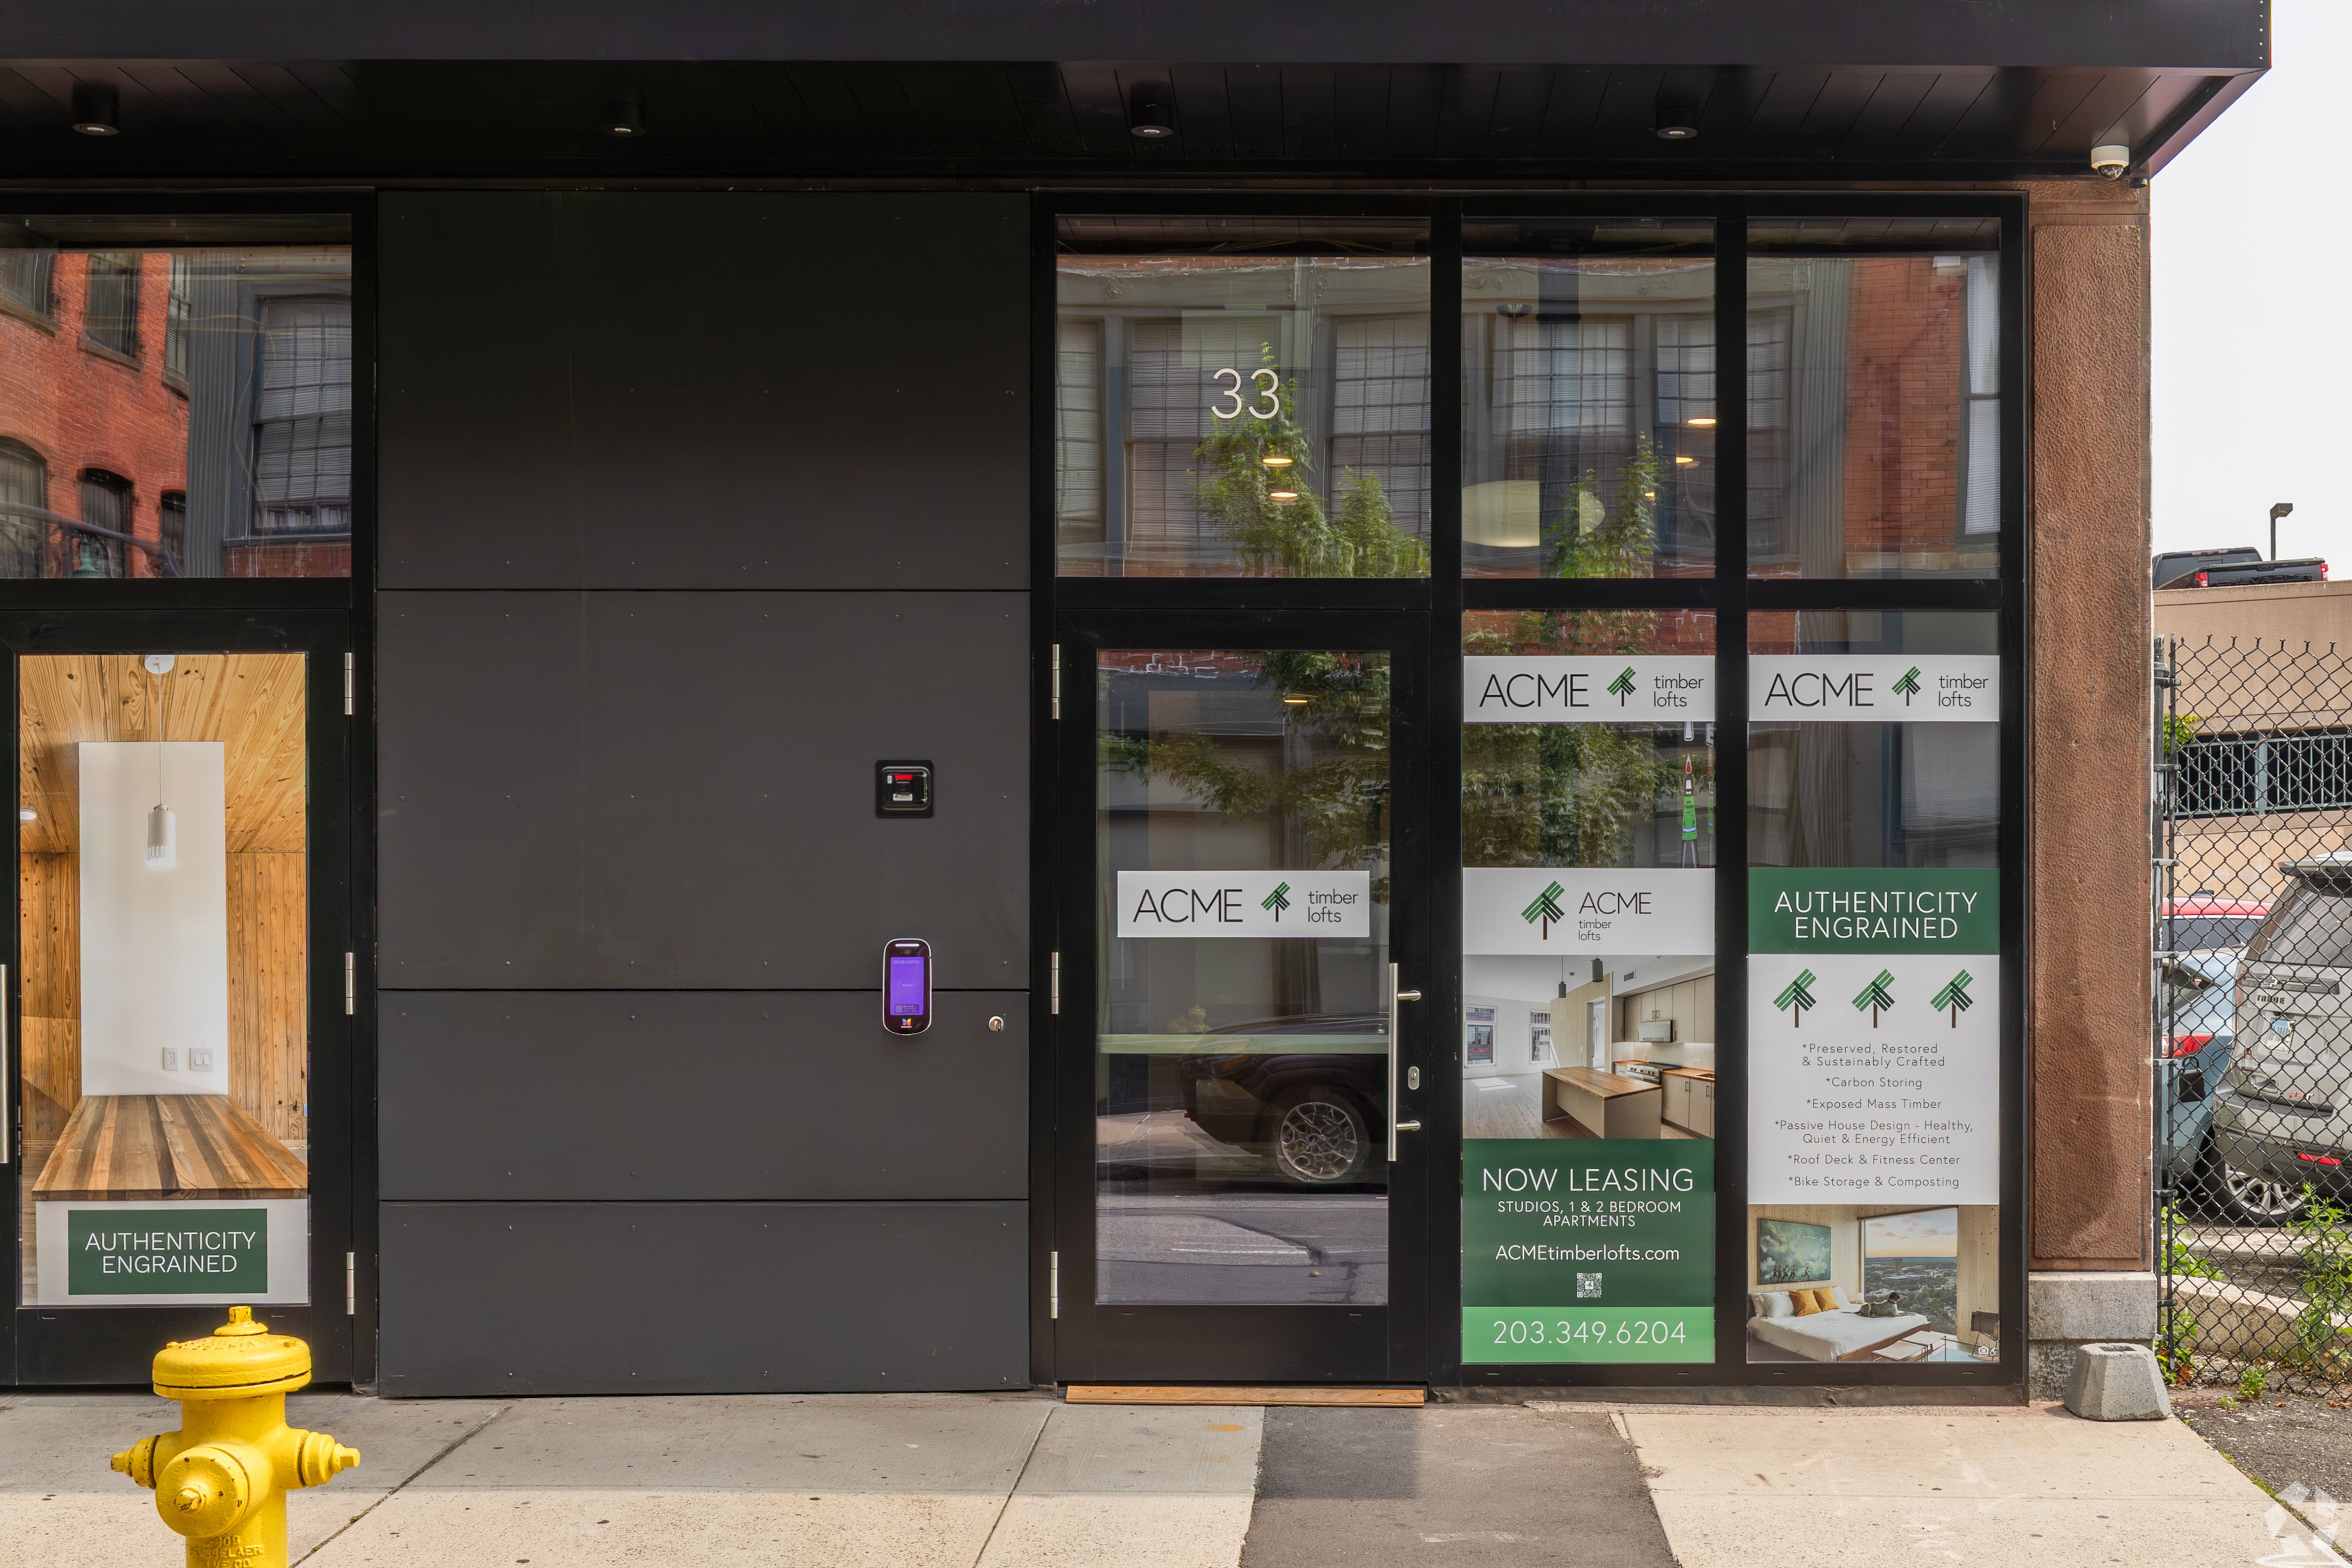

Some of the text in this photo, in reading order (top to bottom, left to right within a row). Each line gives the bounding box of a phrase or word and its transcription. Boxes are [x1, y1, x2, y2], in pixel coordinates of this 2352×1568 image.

[1212, 369, 1279, 418] 33
[1654, 673, 1704, 689] timber
[1939, 673, 1988, 689] timber
[1479, 674, 1589, 707] ACME
[1764, 673, 1874, 707] ACME
[1654, 691, 1687, 707] lofts
[1939, 691, 1971, 707] lofts
[1308, 889, 1358, 904] timber
[1579, 892, 1651, 914] ACME
[1774, 891, 1977, 913] AUTHENTICITY
[1133, 889, 1243, 923] ACME
[1308, 907, 1341, 922] lofts
[1579, 918, 1612, 929] timber
[1796, 917, 1957, 938] ENGRAINED
[1579, 930, 1601, 940] lofts
[1882, 1043, 1937, 1053] Restored
[1803, 1056, 1944, 1069] & Sustainably Crafted
[1880, 1077, 1922, 1090] Storing
[1868, 1099, 1896, 1108] Mass
[1902, 1098, 1941, 1108] Timber
[1829, 1121, 1865, 1130] House
[1871, 1121, 1909, 1132] Design
[1925, 1120, 1972, 1133] Healthy,
[1803, 1133, 1950, 1146] Quiet & Energy Efficient
[1826, 1154, 1853, 1164] Deck
[1859, 1155, 1867, 1164] &
[1873, 1155, 1915, 1164] Fitness
[1920, 1155, 1960, 1164] Center
[1484, 1169, 1692, 1191] NOW LEASING
[1824, 1177, 1869, 1189] Storage
[1875, 1177, 1883, 1186] &
[1888, 1177, 1959, 1189] Composting
[1498, 1201, 1680, 1214] STUDIOS, 1 & 2 BEDROOM
[1543, 1215, 1635, 1226] APARTMENTS
[85, 1232, 255, 1250] AUTHENTICITY
[1496, 1244, 1679, 1260] ACMEtimberlofts.com
[103, 1255, 237, 1273] ENGRAINED
[1494, 1321, 1686, 1344] 203.349.6204
